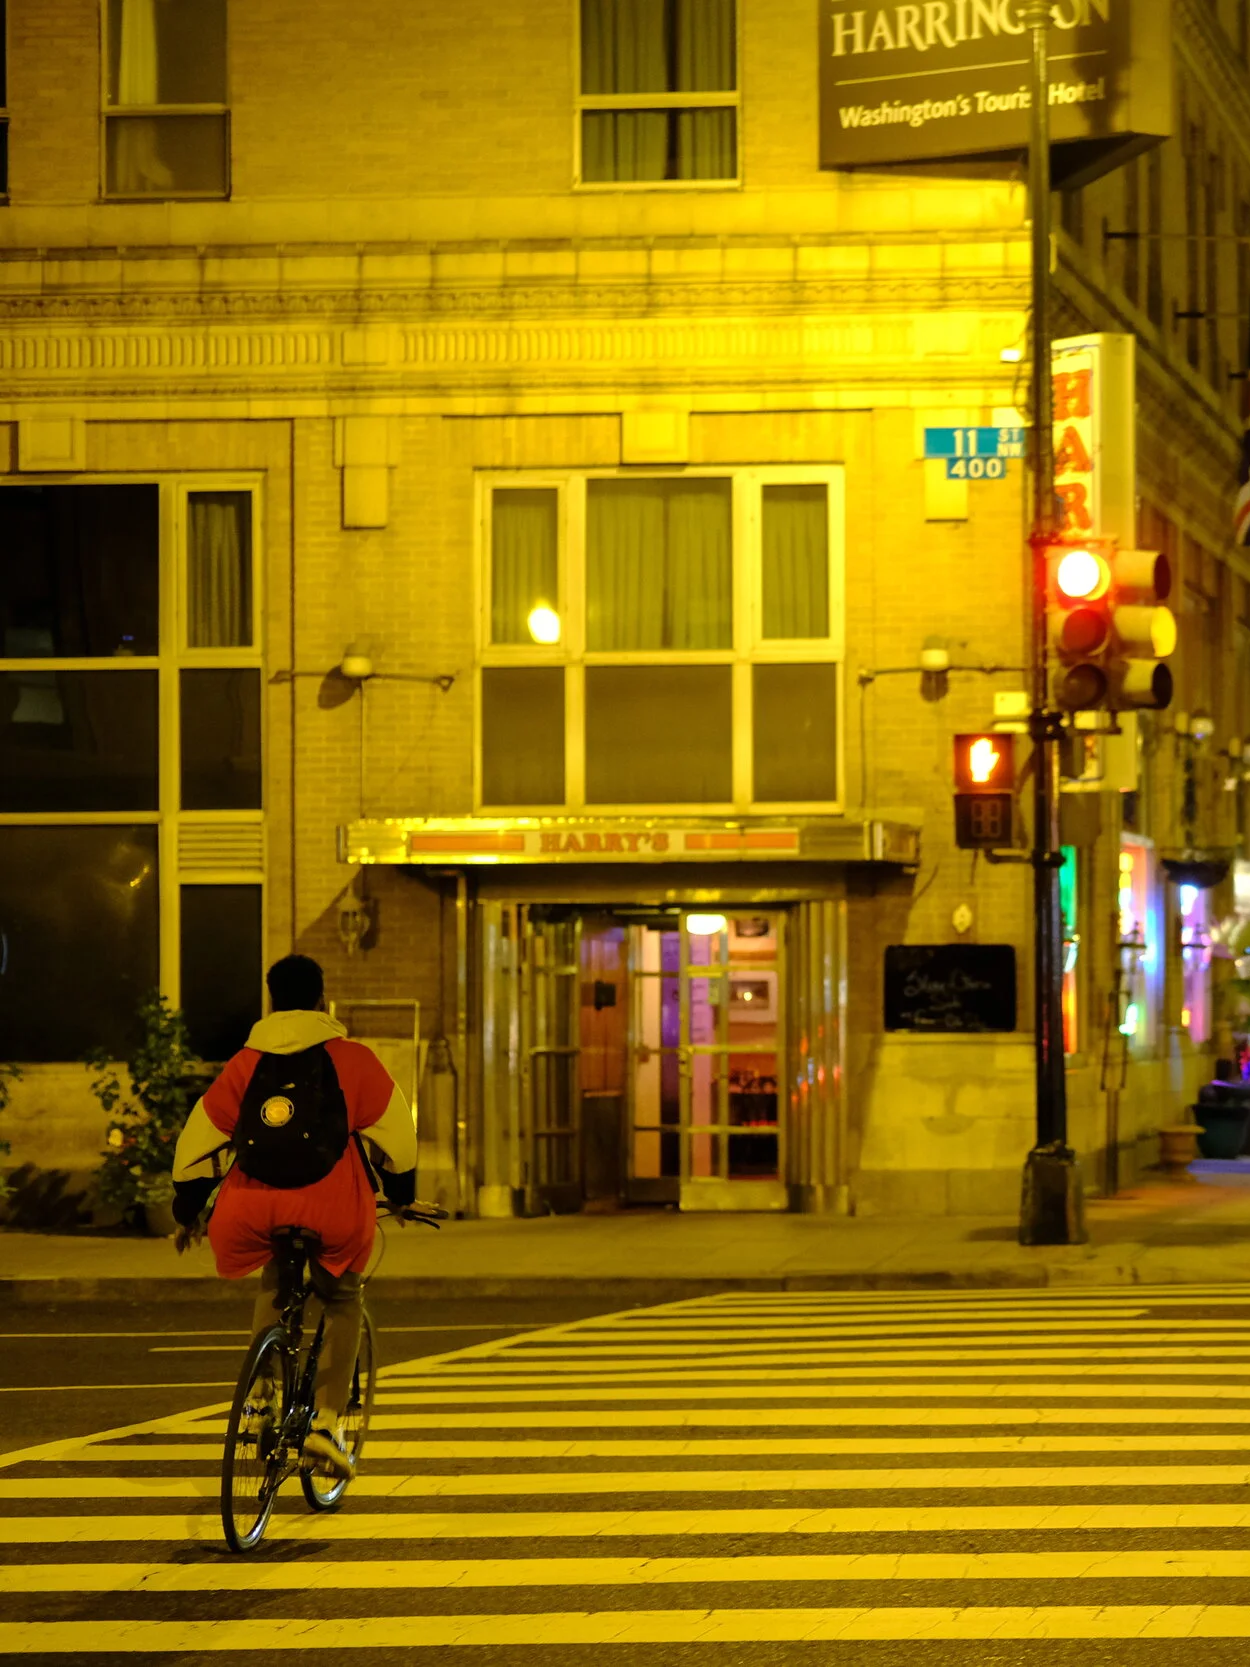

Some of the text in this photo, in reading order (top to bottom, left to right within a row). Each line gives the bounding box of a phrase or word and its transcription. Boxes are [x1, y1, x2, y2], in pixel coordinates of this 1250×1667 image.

[831, 0, 1109, 57] HARRINGON
[839, 94, 971, 128] Washington's
[1047, 77, 1105, 106] Hotel
[953, 428, 1020, 458] 11 ST
[950, 458, 1003, 478] 400
[540, 832, 669, 853] HARRY'S
